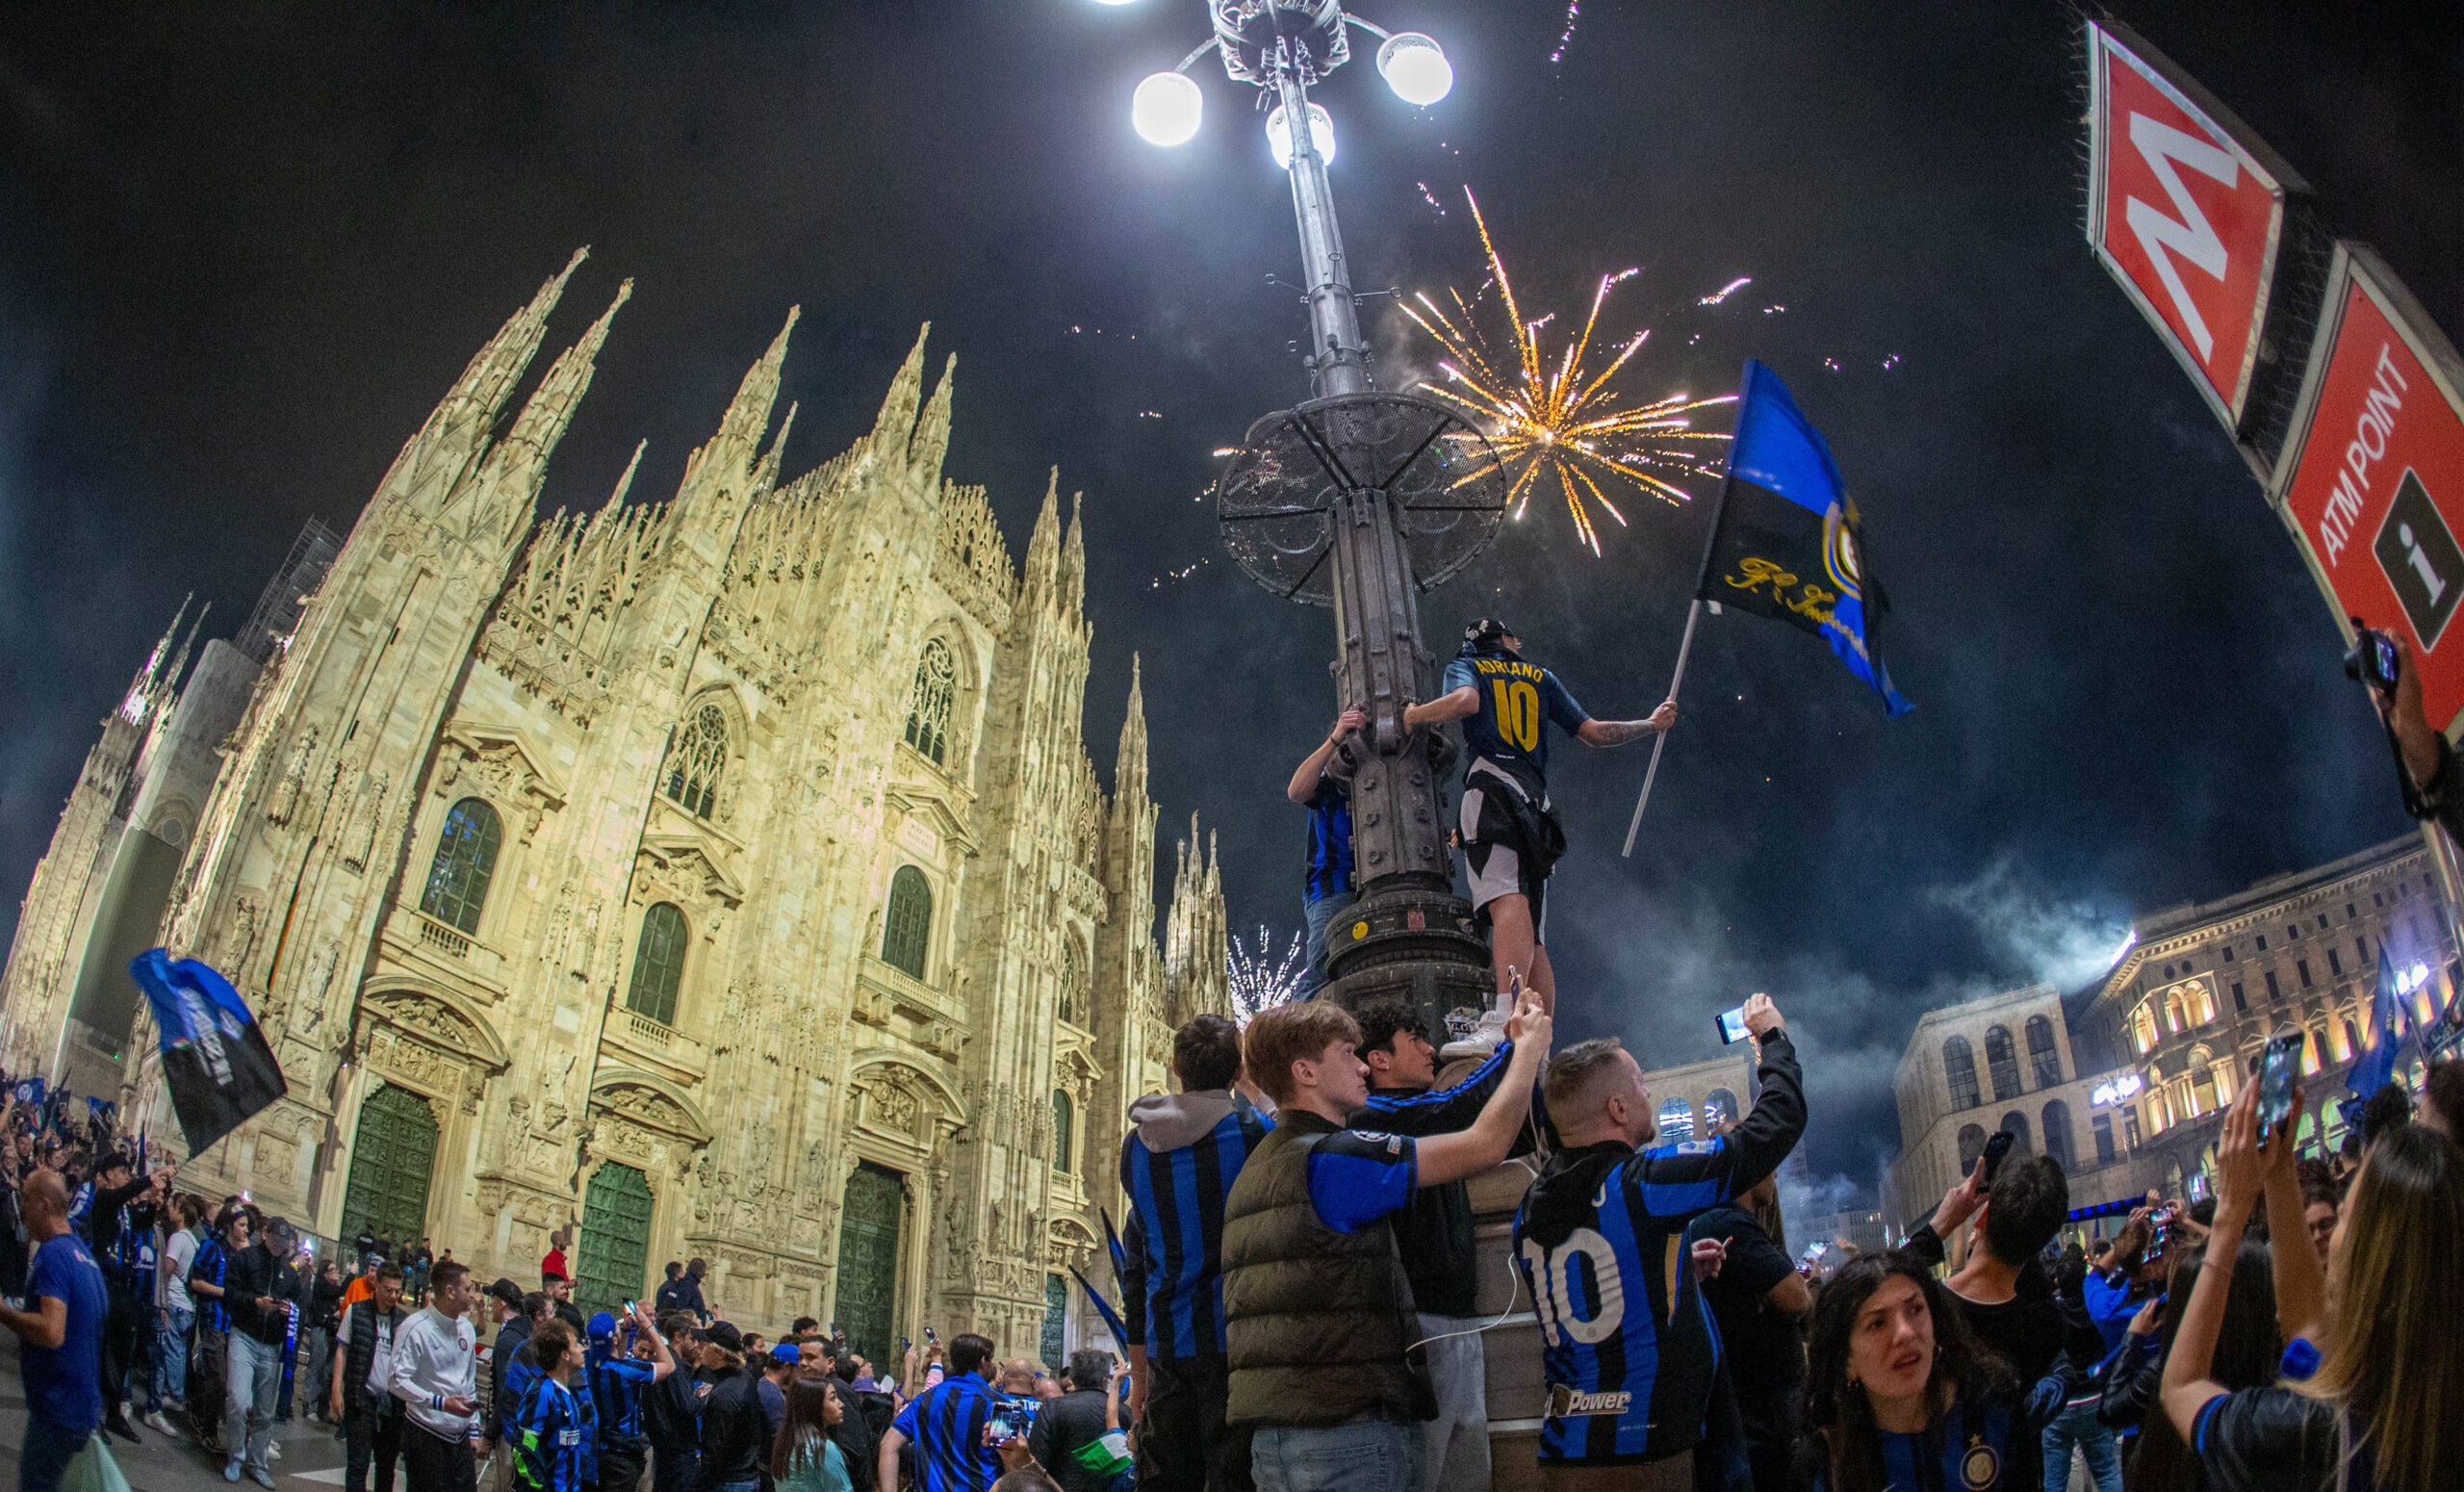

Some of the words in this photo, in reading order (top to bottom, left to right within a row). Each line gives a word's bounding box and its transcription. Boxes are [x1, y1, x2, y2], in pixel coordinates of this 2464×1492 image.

[2126, 110, 2240, 366] M
[2319, 468, 2363, 568] ATM
[2346, 342, 2408, 491] POINT
[1475, 659, 1544, 683] ADRIANO
[1493, 678, 1539, 753] 10
[1523, 1227, 1625, 1347] 10
[1566, 1389, 1631, 1416] Power
